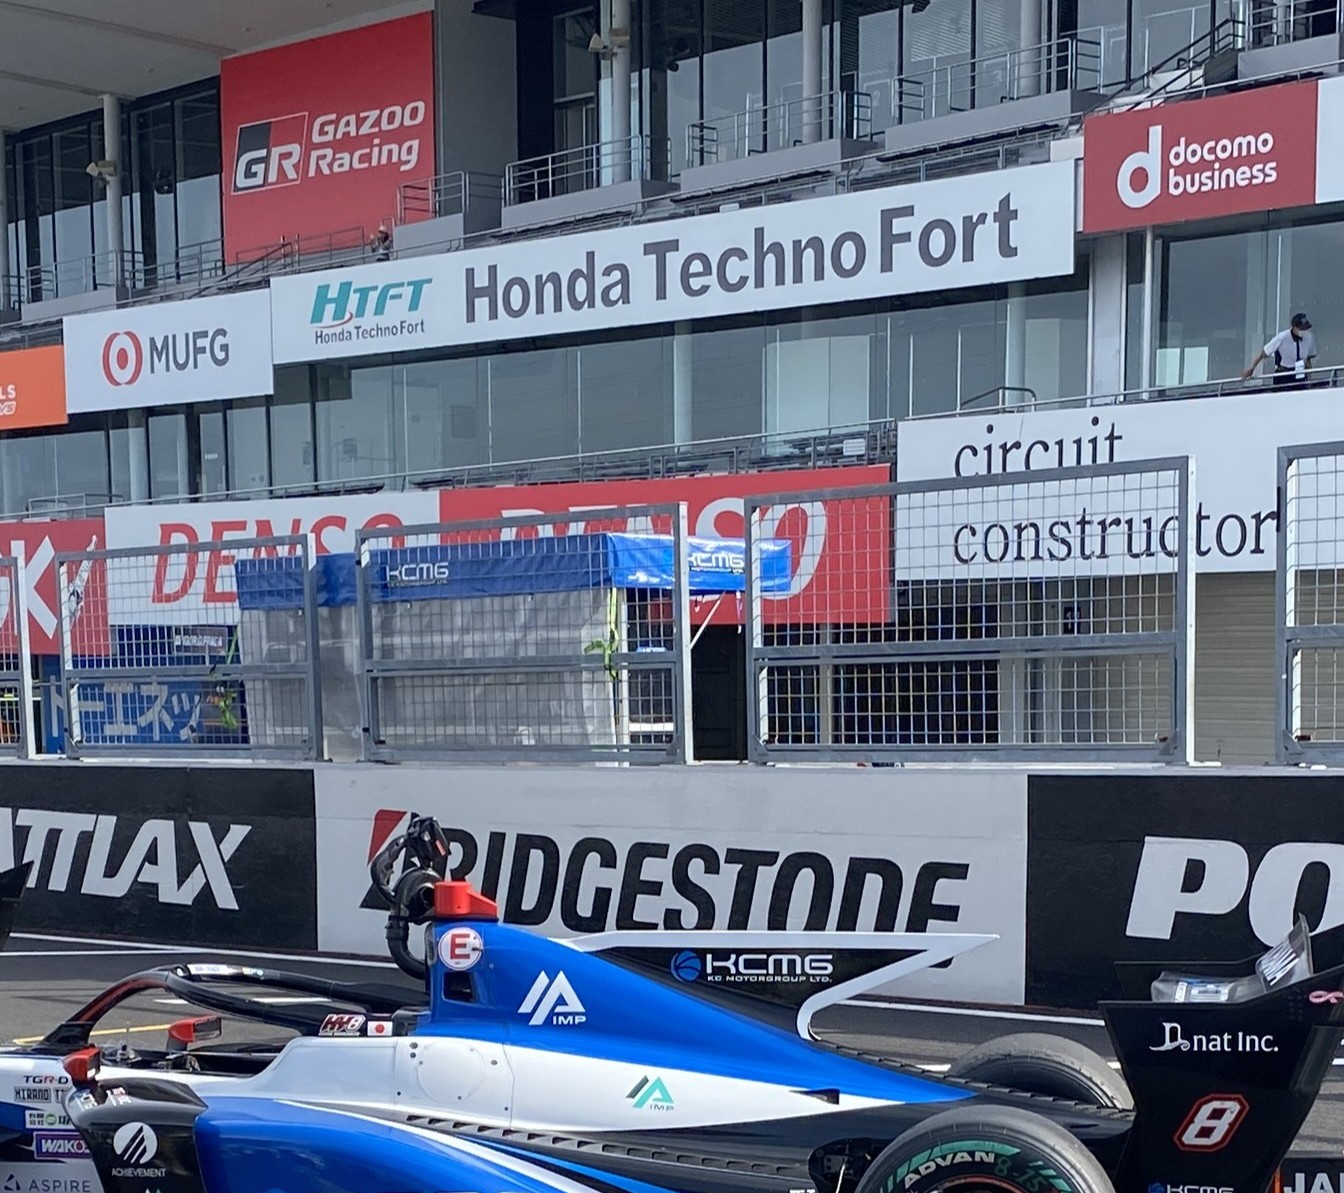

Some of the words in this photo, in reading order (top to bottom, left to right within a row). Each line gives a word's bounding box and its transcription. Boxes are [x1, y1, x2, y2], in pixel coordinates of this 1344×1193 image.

[311, 101, 426, 142] GAZOO
[307, 138, 420, 176] Racing
[1168, 129, 1274, 166] docomo
[235, 145, 302, 191] GR
[1168, 160, 1278, 197] business
[465, 250, 632, 323] Honda
[148, 327, 230, 375] MUFG
[314, 328, 352, 345] Honda
[954, 415, 1122, 480] circuit
[953, 502, 1278, 564] constructor
[388, 562, 449, 581] KCMG
[706, 954, 833, 974] KCMG
[552, 1014, 587, 1025] IMP
[1238, 1031, 1280, 1052] Inc.
[649, 1103, 675, 1111] IMP
[1181, 1099, 1237, 1146] 8
[28, 1178, 91, 1193] ASPIRE
[111, 1166, 167, 1178] ACHIEVEMENT
[904, 1151, 995, 1190] ADVAN
